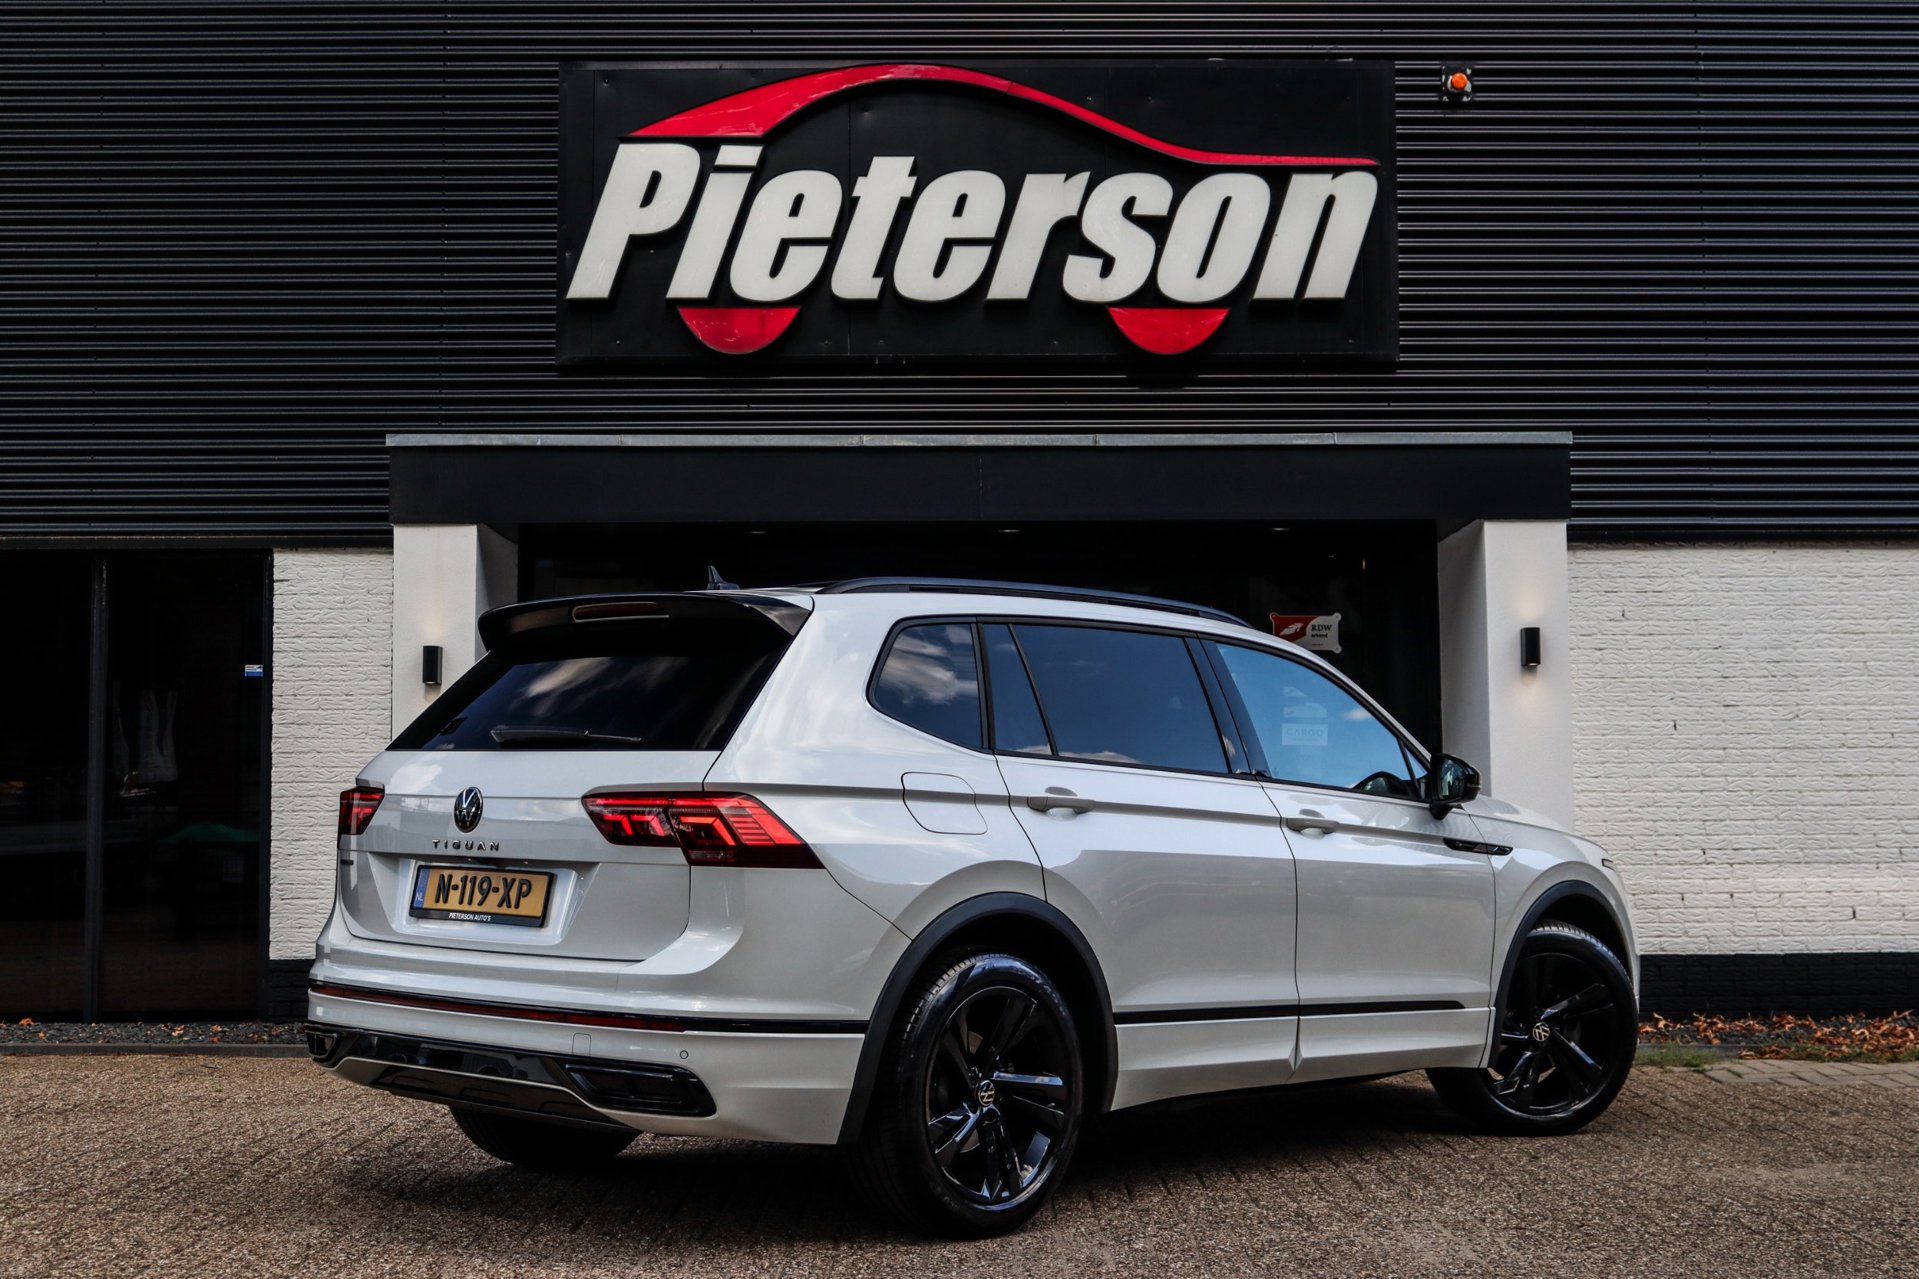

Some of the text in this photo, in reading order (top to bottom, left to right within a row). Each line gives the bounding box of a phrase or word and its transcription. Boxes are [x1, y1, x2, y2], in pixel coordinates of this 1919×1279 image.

[565, 142, 1379, 303] Pieterson
[1311, 623, 1333, 632] RDW
[432, 839, 500, 851] TIGUAN
[434, 873, 532, 909] N-119-XP
[448, 912, 492, 922] PIETERSON AUTO'S
